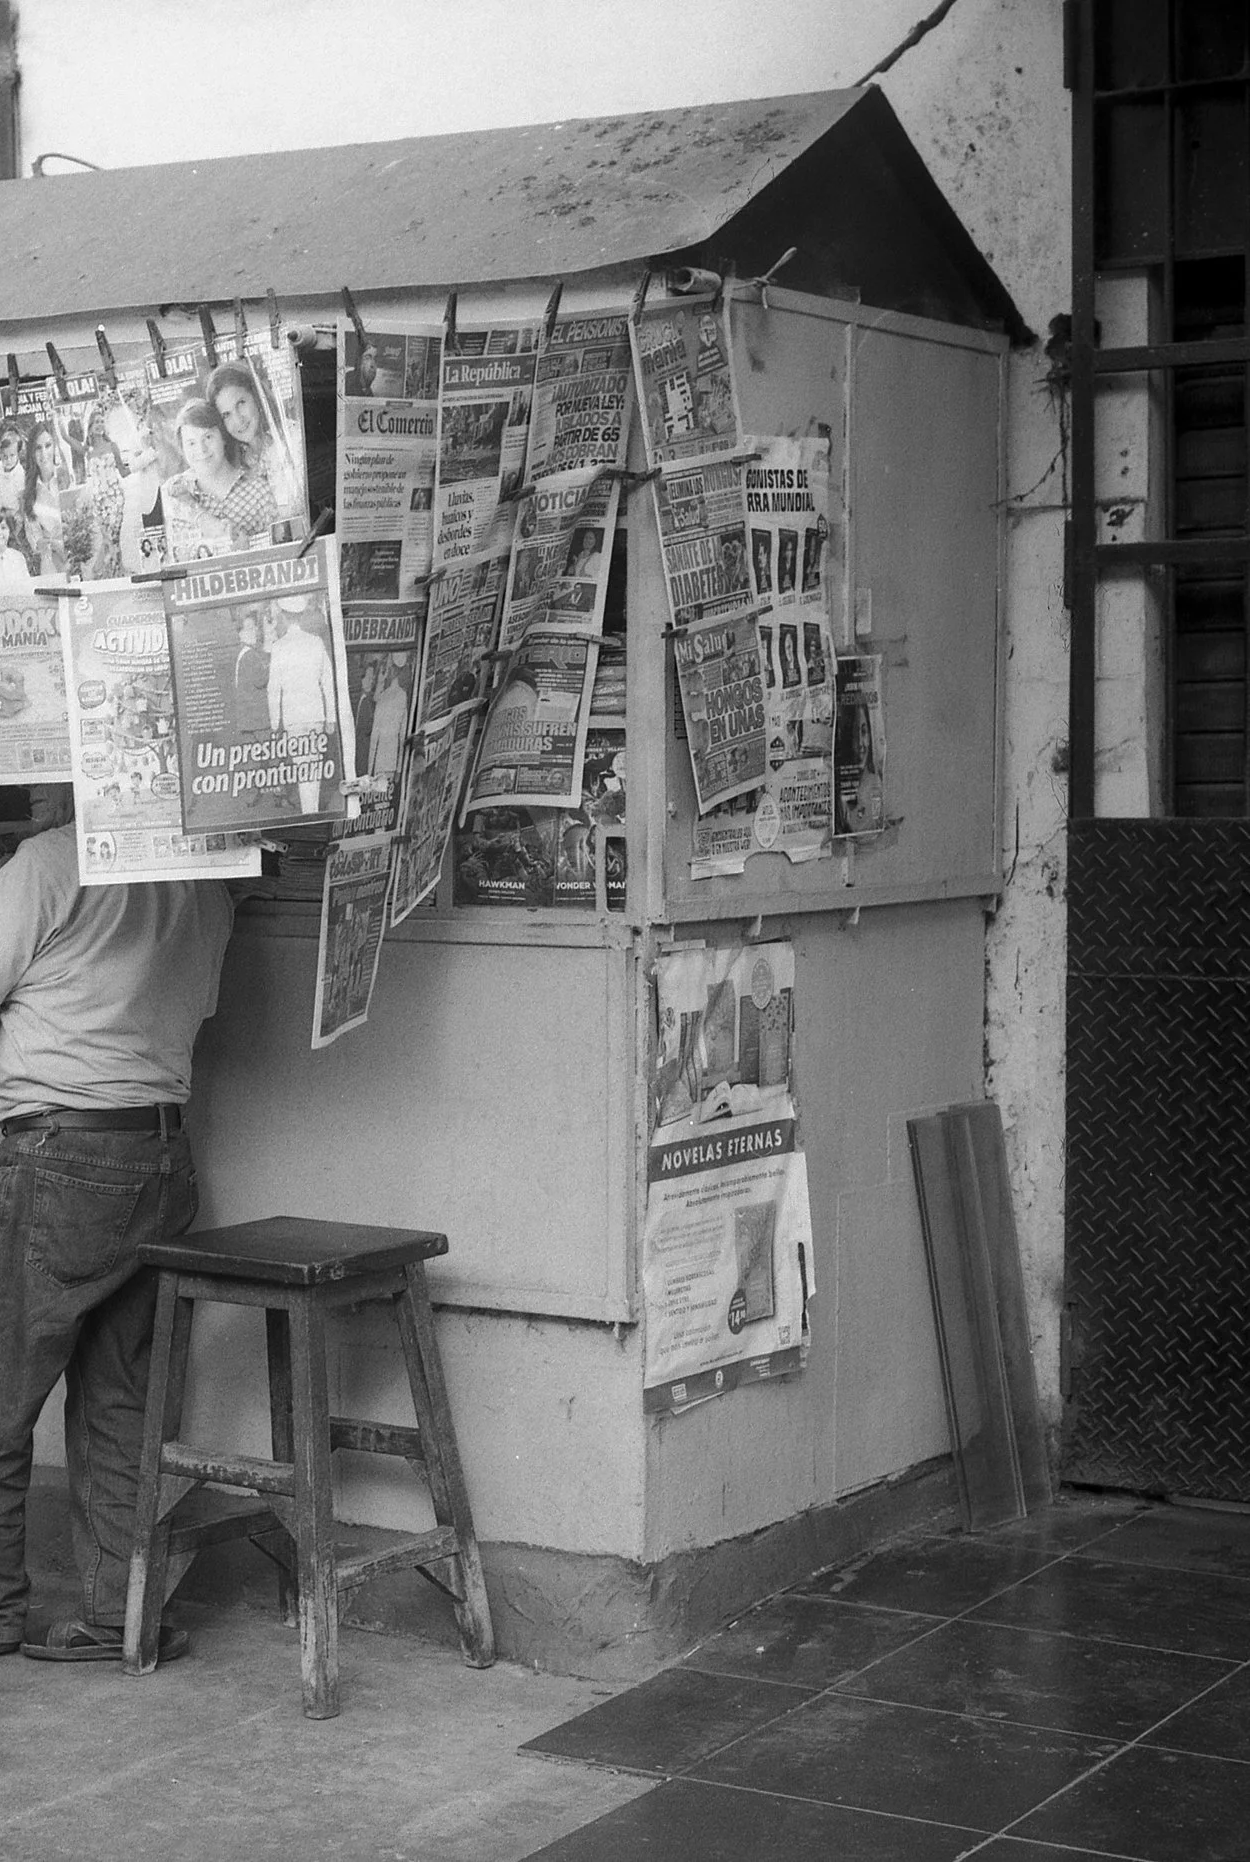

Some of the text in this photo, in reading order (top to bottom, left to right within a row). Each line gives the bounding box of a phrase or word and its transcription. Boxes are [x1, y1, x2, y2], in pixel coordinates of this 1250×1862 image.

[151, 353, 193, 379] ¡OLA!
[445, 366, 459, 383] La
[461, 361, 521, 386] República
[54, 376, 95, 399] ¡OLA!
[358, 410, 433, 434] El Comercio
[583, 426, 600, 442] DE
[601, 426, 620, 442] 65
[796, 469, 809, 490] DE
[772, 492, 815, 514] MUNDIAL
[175, 556, 318, 602] HILDEBRANDT
[705, 677, 763, 720] HONGOS
[523, 722, 577, 737] SUFREN
[710, 716, 727, 746] EN
[197, 730, 329, 771] Un presidente
[192, 773, 229, 795] con
[232, 754, 335, 797] prontuario
[478, 879, 525, 890] HAWKMAN
[661, 1128, 783, 1172] NOVELAS ETERNAS
